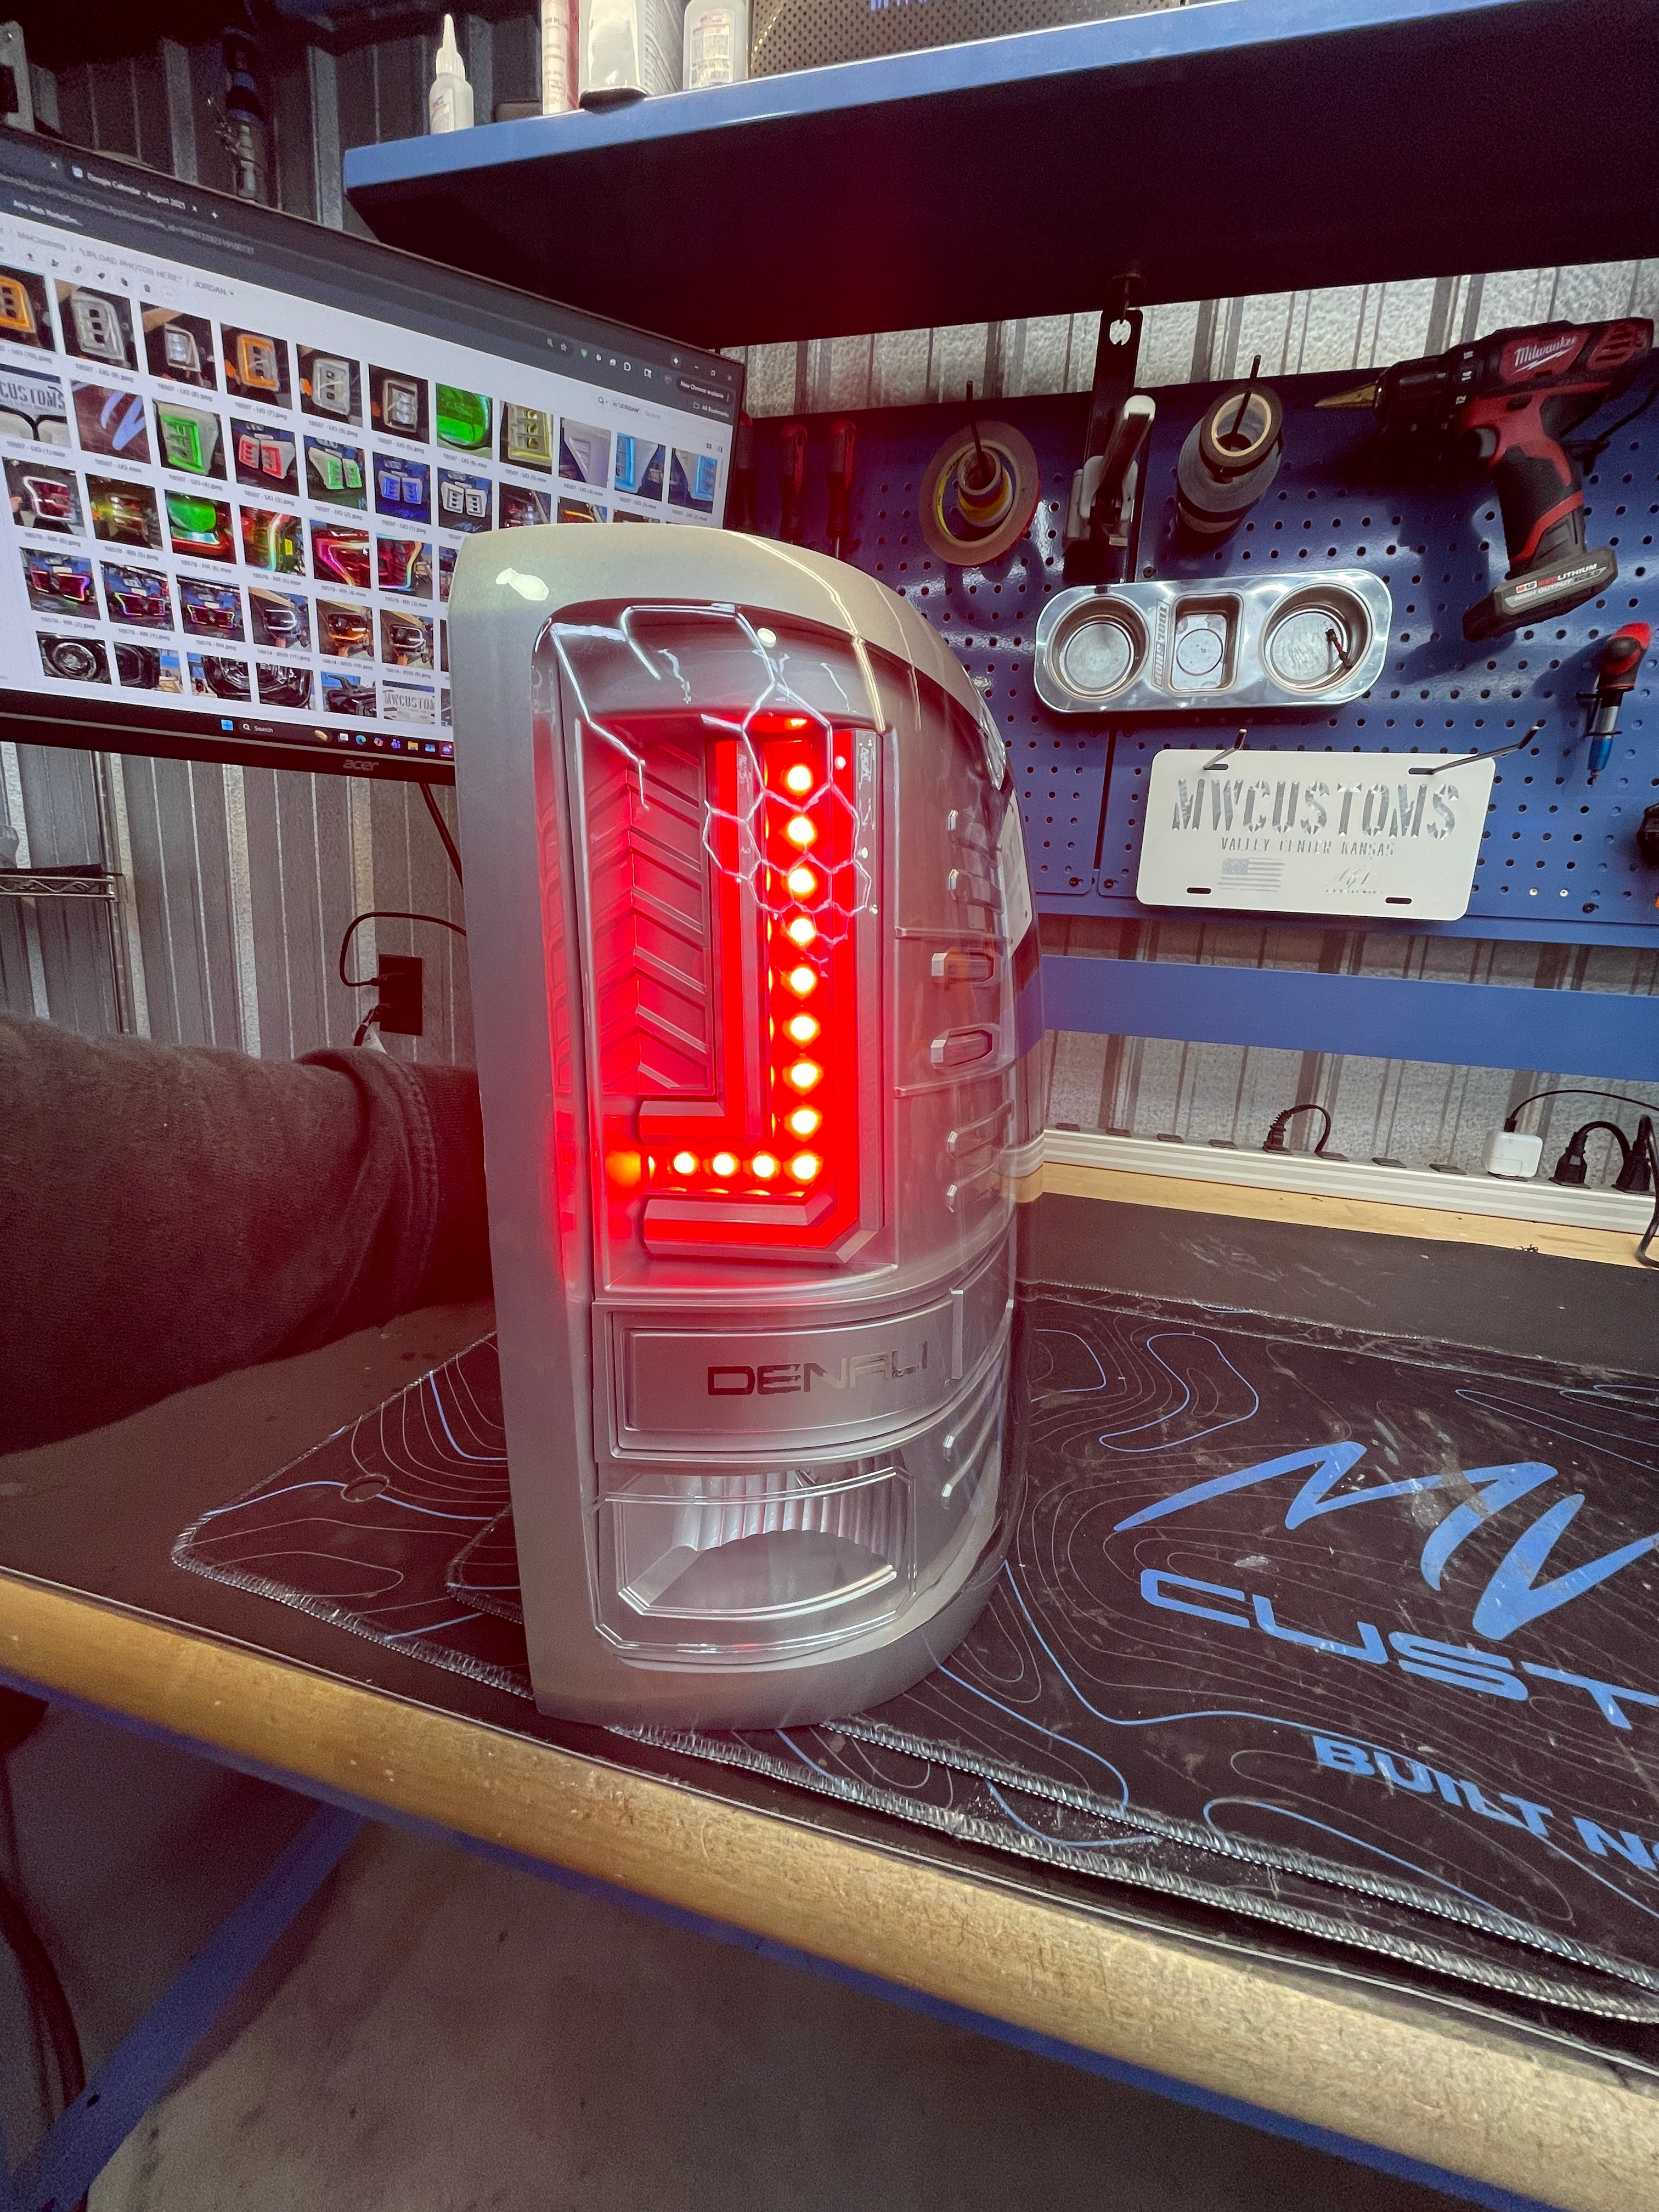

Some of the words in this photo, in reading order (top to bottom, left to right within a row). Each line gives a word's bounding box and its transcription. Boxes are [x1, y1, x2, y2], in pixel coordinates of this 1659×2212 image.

[194, 281, 226, 295] JORDAN
[1514, 336, 1577, 367] Milwaukee
[1155, 643, 1165, 687] SHOP
[343, 759, 379, 771] acer
[1172, 778, 1459, 840] MWCUSTOMS
[1341, 841, 1394, 856] KANSAS
[707, 1340, 928, 1396] DENALI
[1141, 1568, 1659, 1730] CUST
[1312, 1735, 1554, 1838] BUILT
[1572, 1816, 1659, 1871] N
